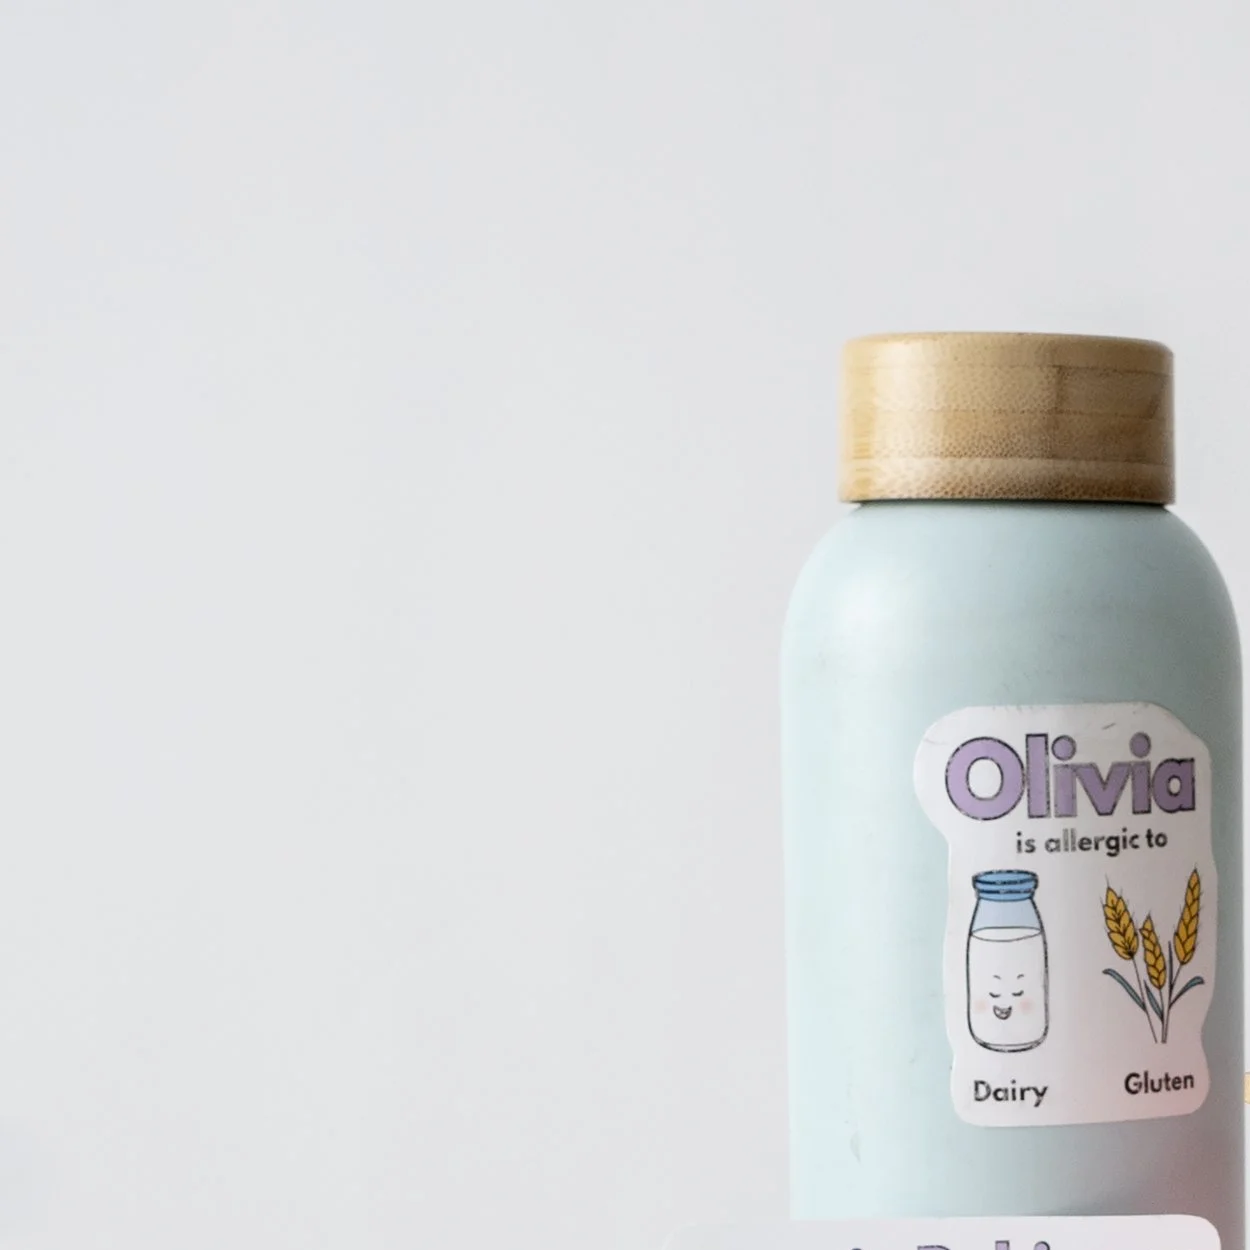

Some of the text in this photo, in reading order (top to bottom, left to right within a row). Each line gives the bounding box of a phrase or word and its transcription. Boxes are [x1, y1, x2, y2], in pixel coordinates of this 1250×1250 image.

[944, 732, 1198, 822] Olivia
[1016, 826, 1168, 858] is allergic to
[973, 1079, 1049, 1108] Dairy
[1124, 1070, 1195, 1096] Gluten
